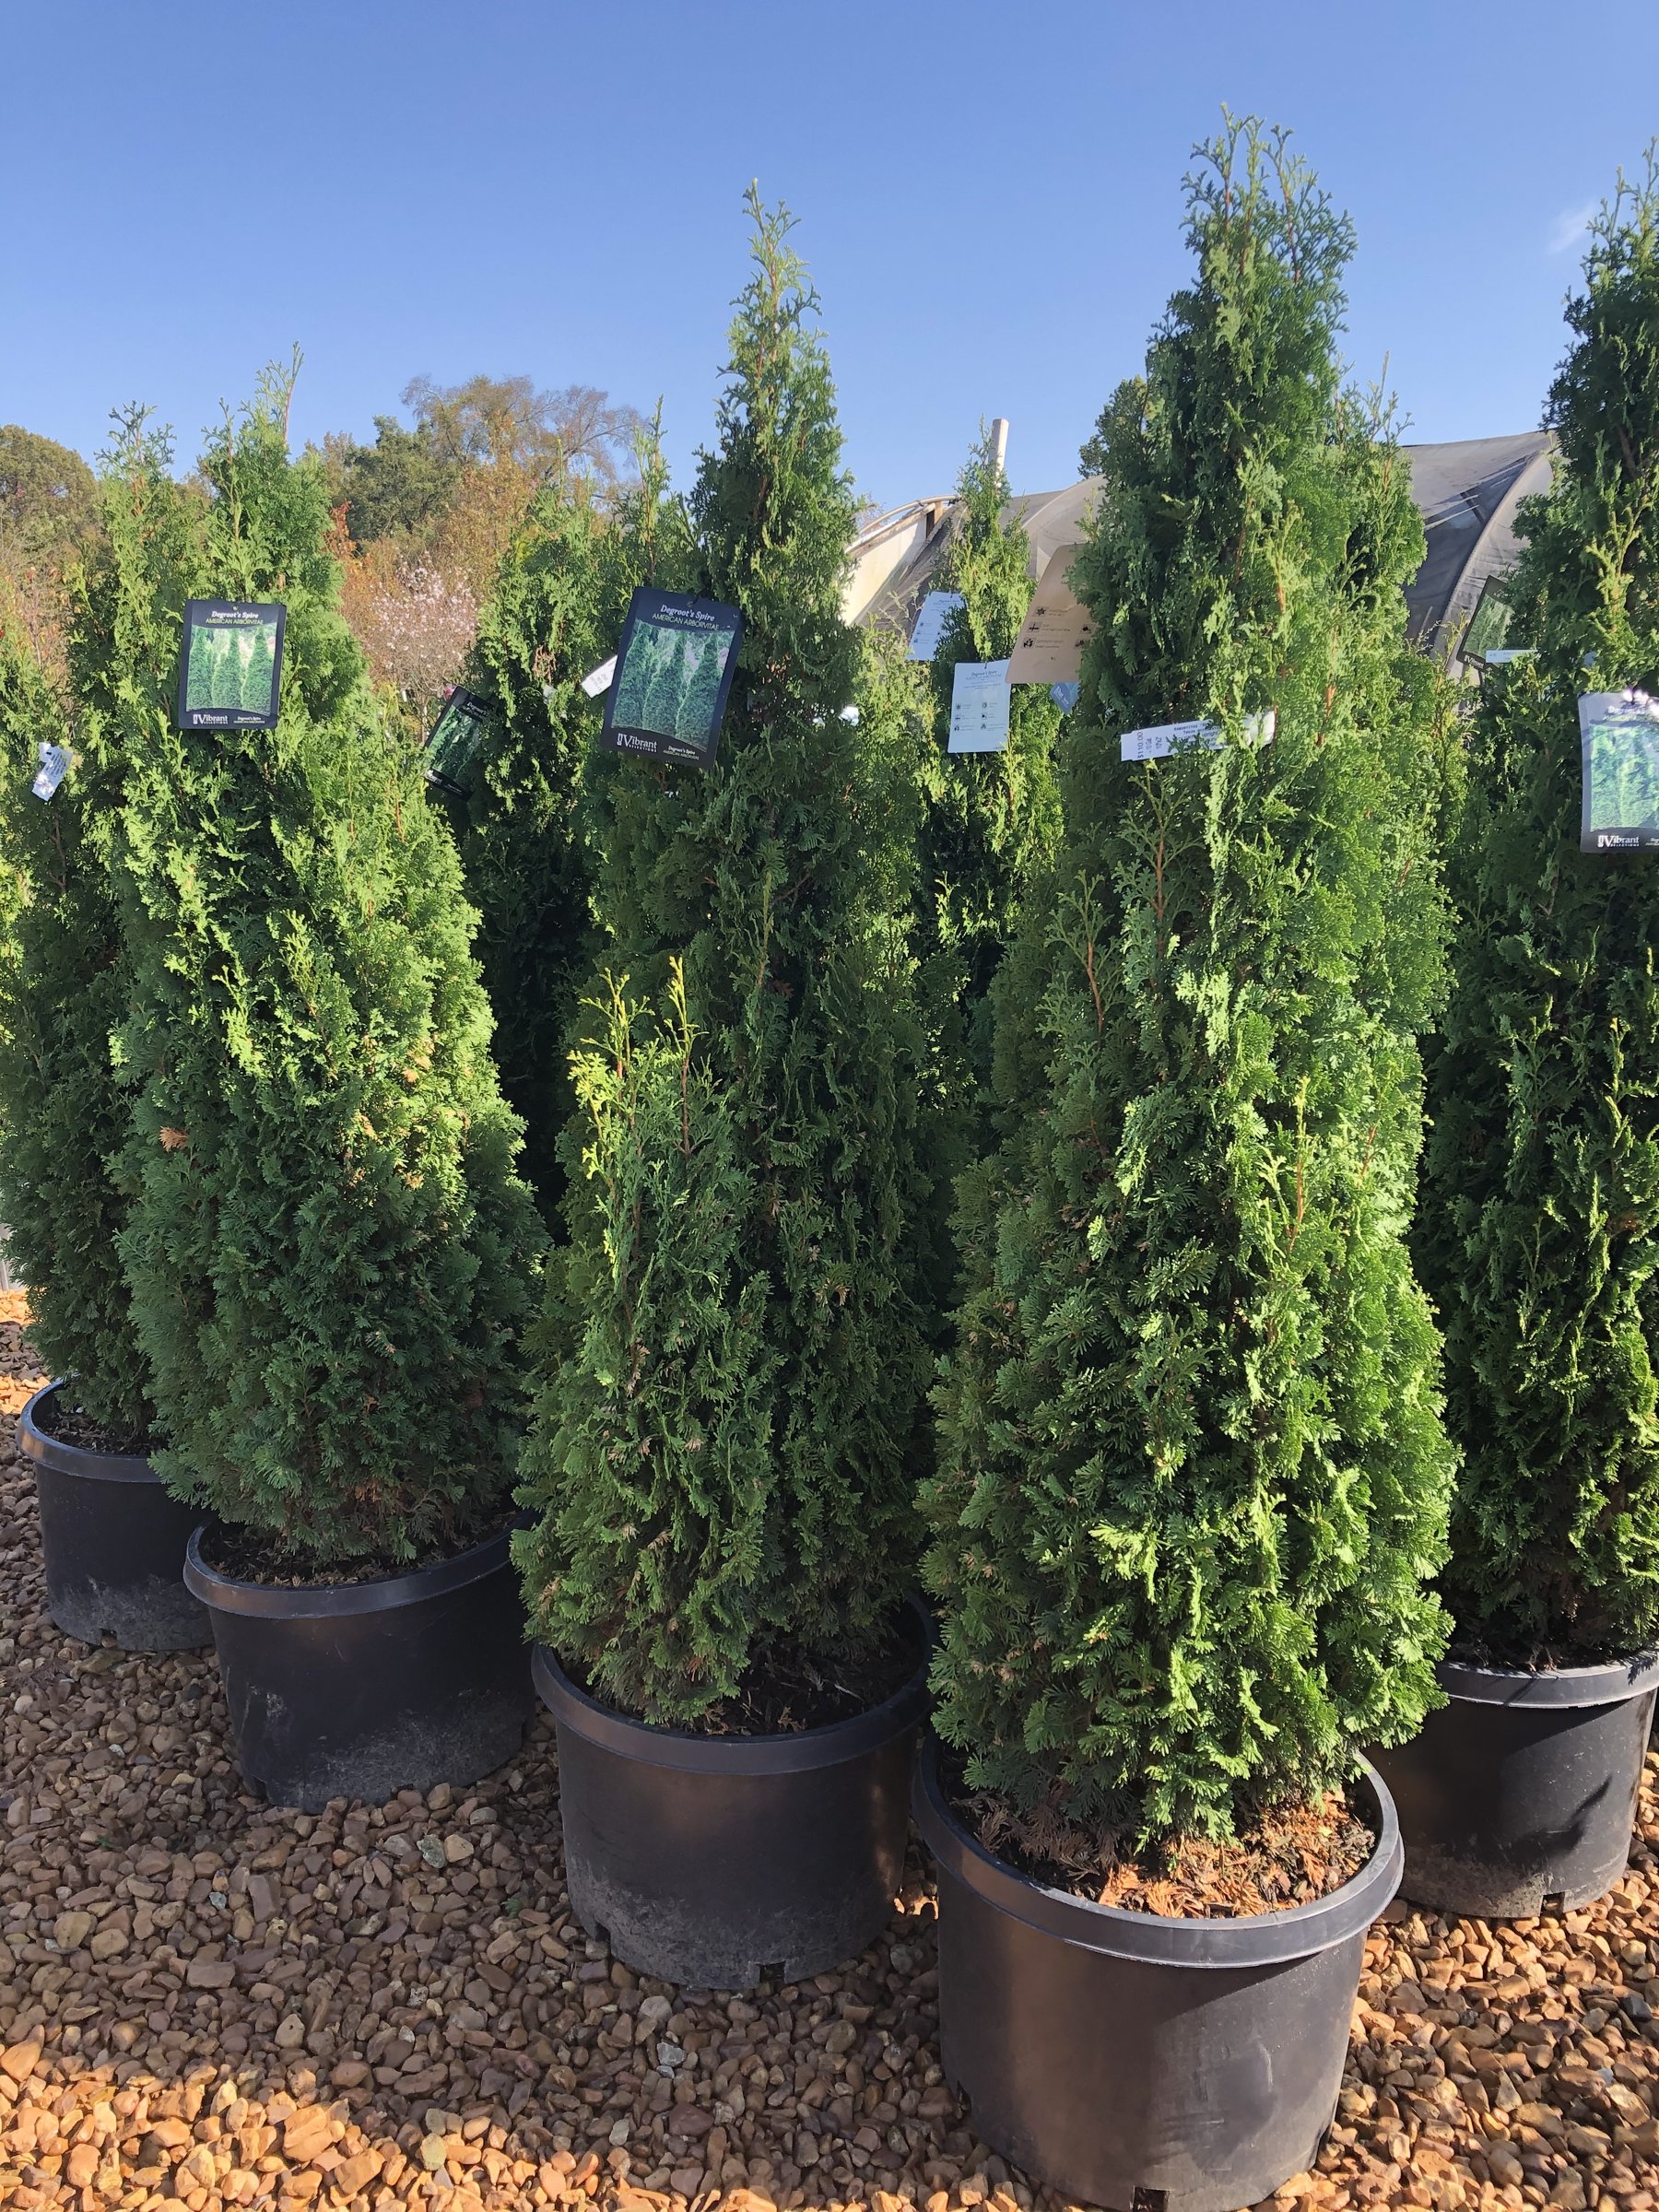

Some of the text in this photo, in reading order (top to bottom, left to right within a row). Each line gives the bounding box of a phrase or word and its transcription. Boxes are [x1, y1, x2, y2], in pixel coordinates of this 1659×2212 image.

[211, 610, 259, 620] Degroot's Spire
[661, 604, 715, 621] Degroot's Spire
[652, 613, 720, 630] AMERICAN ARBORVITAE
[198, 713, 229, 724] Vibrant
[623, 734, 657, 749] Vibrant
[629, 743, 657, 753] SELECTIONS
[667, 745, 686, 754] Degroot's
[1604, 834, 1640, 847] Vibrant
